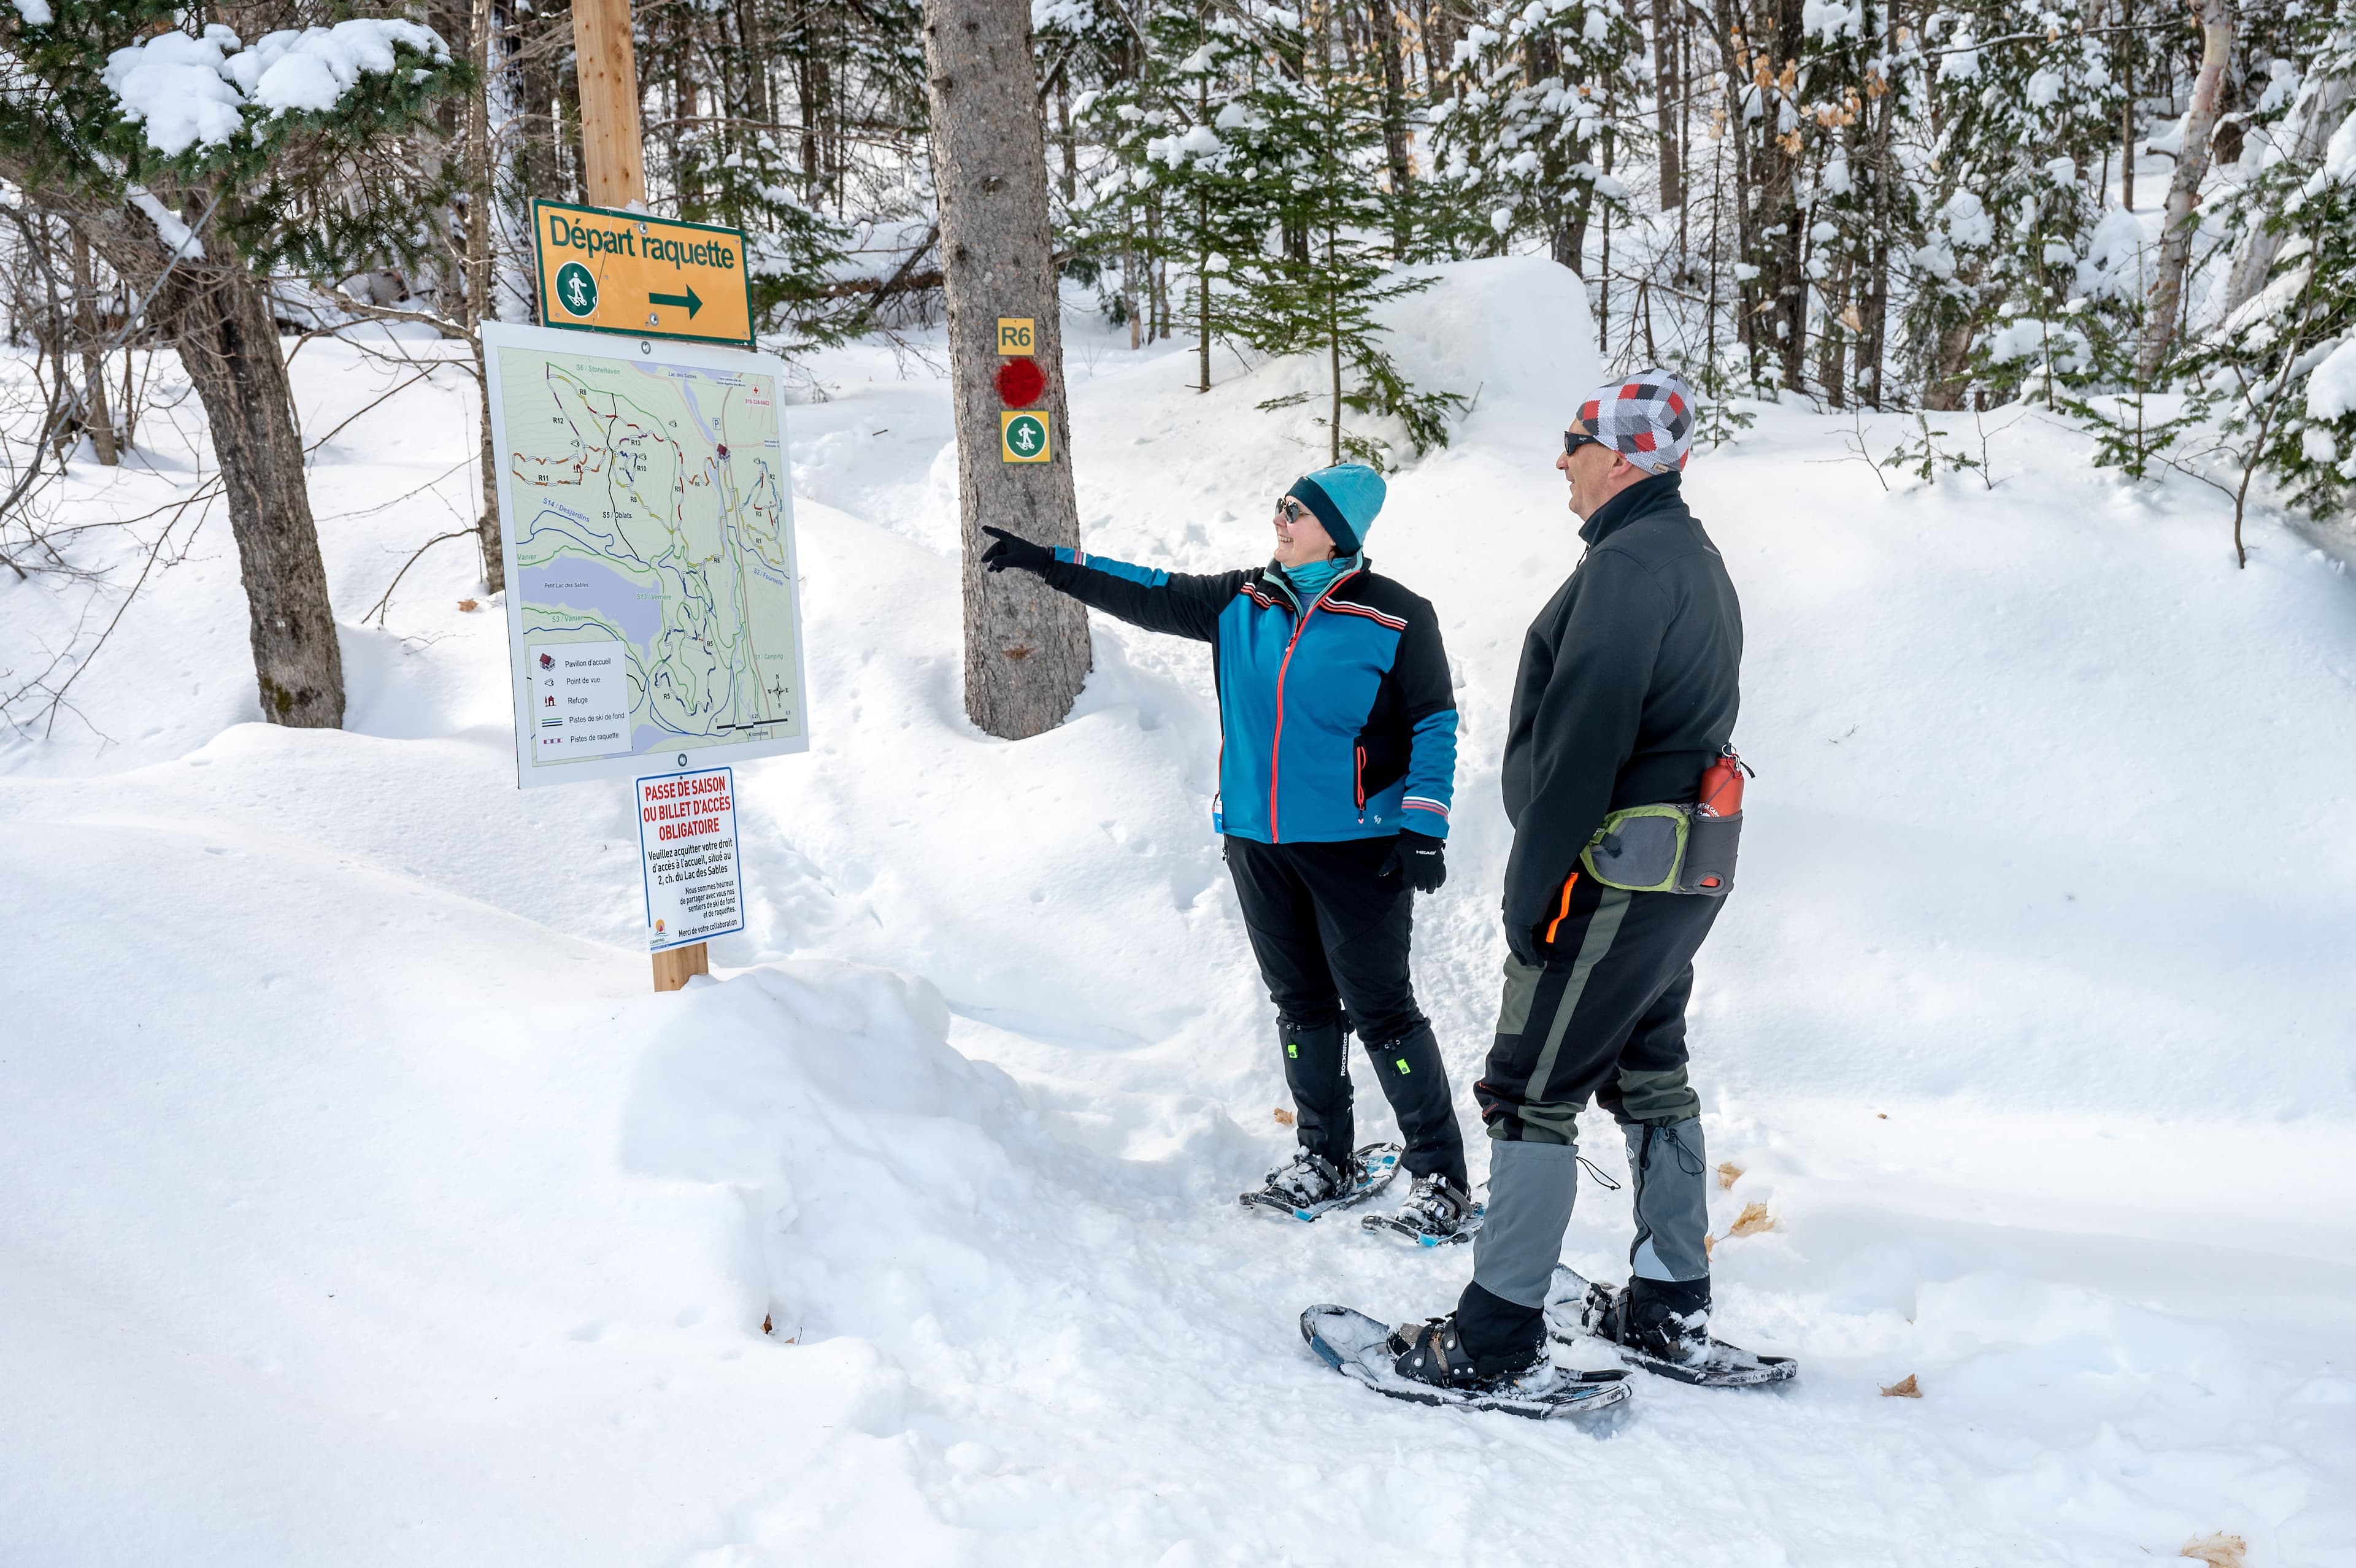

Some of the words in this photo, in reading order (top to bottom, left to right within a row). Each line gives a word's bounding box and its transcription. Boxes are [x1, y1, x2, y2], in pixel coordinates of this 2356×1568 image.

[549, 215, 636, 258] Départ
[642, 235, 734, 270] raquette
[1001, 326, 1031, 346] R6
[588, 366, 621, 375] Stonehaven
[543, 498, 555, 507] S14
[559, 504, 590, 523] Desjardins
[763, 572, 783, 586] Fournelle
[588, 658, 611, 666] d'accueil
[764, 653, 783, 663] Camping
[597, 732, 619, 741] raquette
[645, 782, 675, 801] PASSE
[677, 780, 690, 797] DE
[691, 775, 726, 795] SAISON
[643, 806, 657, 823] OU
[658, 801, 691, 820] BILLET
[693, 792, 731, 815] D'ACCÈS
[659, 818, 720, 841] OBLIGATOIRE
[648, 849, 672, 861] Veuillez
[674, 845, 701, 857] acquitter
[702, 841, 717, 851] votre
[718, 838, 733, 848] droit
[652, 861, 675, 873] d'accès
[676, 859, 680, 869] à
[681, 855, 707, 867] l'accueil,
[709, 851, 723, 863] situé
[658, 875, 664, 886] 2,
[665, 874, 674, 883] ch.
[676, 872, 683, 882] du
[685, 871, 695, 880] Lac
[696, 868, 707, 877] des
[708, 864, 728, 875] Sables
[698, 883, 716, 893] sommes
[687, 894, 705, 905] partager
[688, 903, 706, 912] sentiers
[714, 906, 736, 917] raquettes.
[679, 928, 691, 937] Merci
[698, 924, 709, 933] votre
[709, 919, 737, 930] collaboration
